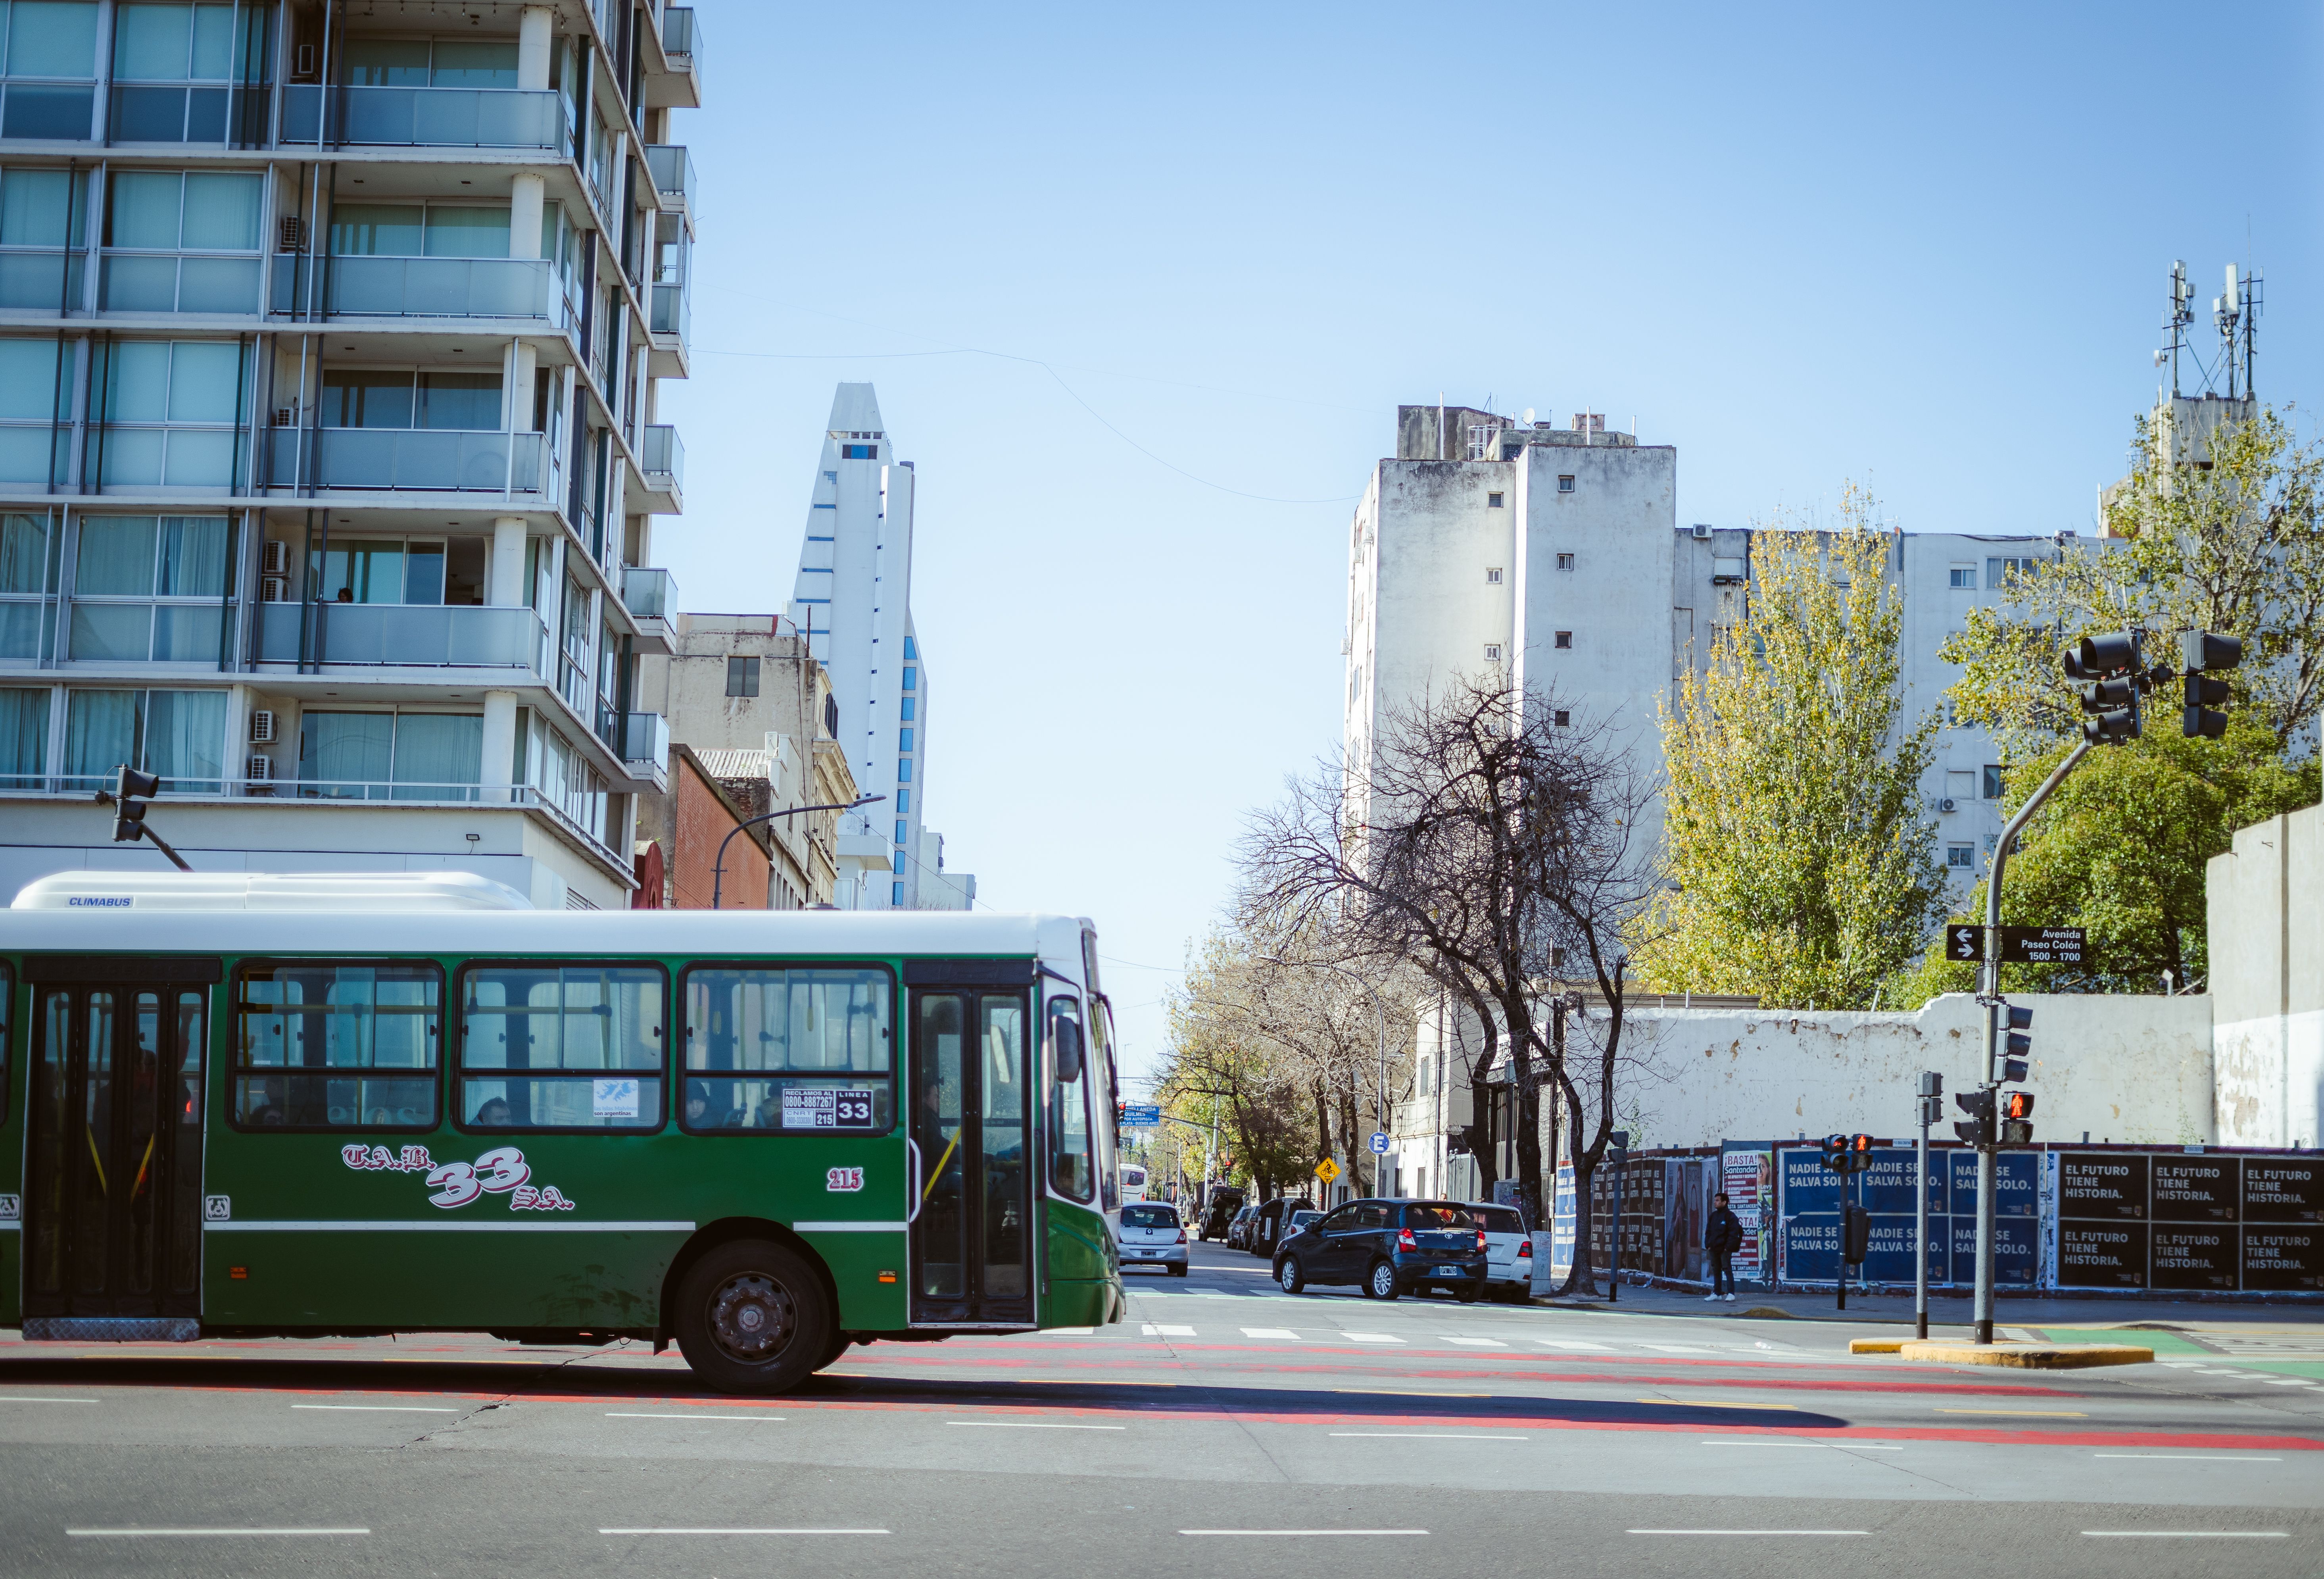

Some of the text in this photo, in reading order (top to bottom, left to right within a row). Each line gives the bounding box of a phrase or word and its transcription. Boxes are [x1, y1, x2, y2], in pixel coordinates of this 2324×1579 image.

[69, 897, 130, 906] CLIMABUS
[2042, 929, 2080, 939] Avenida
[2022, 940, 2080, 949] Paseo Colón
[2029, 952, 2050, 960] 1500
[785, 1096, 833, 1107] 0800-8887267
[839, 1103, 869, 1118] 33
[817, 1114, 832, 1124] 215
[1374, 1136, 1384, 1150] E
[1725, 1155, 1757, 1166] ¡BASTA!
[1725, 1166, 1757, 1174] Santander
[1789, 1164, 1821, 1173] NADIE
[1867, 1163, 1902, 1172] NADIE
[1996, 1166, 2010, 1176] SE
[2066, 1165, 2129, 1176] EL FUTURO
[2157, 1167, 2220, 1178] EL FUTURO
[426, 1147, 530, 1208] 33
[828, 1168, 863, 1190] 215
[2247, 1170, 2311, 1180] EL FUTURO
[1789, 1177, 1821, 1187] SALVA
[1867, 1176, 1902, 1186] SALVA
[1956, 1179, 2031, 1190] SAL SOLO.
[2066, 1177, 2098, 1187] TIENE
[2157, 1179, 2190, 1189] TIENE
[2247, 1181, 2281, 1191] TIENE
[2066, 1188, 2123, 1199] HISTORIA.
[2157, 1191, 2214, 1201] HISTORIA.
[2247, 1193, 2305, 1203] HISTORIA.
[1791, 1227, 1837, 1237] NADIE SE
[1869, 1228, 1903, 1238] NADIE
[1996, 1231, 2010, 1241] SE
[2065, 1231, 2128, 1242] EL FUTURO
[2156, 1235, 2220, 1245] EL FUTURO
[2247, 1236, 2311, 1246] EL FUTURO
[1791, 1241, 1822, 1250] SALVA
[1867, 1242, 1903, 1252] SALVA
[1955, 1243, 2031, 1254] SAL SOLO.
[2065, 1243, 2098, 1253] TIENE
[2156, 1246, 2190, 1256] TIENE
[2247, 1248, 2280, 1257] TIENE
[2065, 1255, 2122, 1266] HISTORIA.
[2156, 1258, 2214, 1268] HISTORIA.
[2247, 1260, 2305, 1269] HISTORIA.
